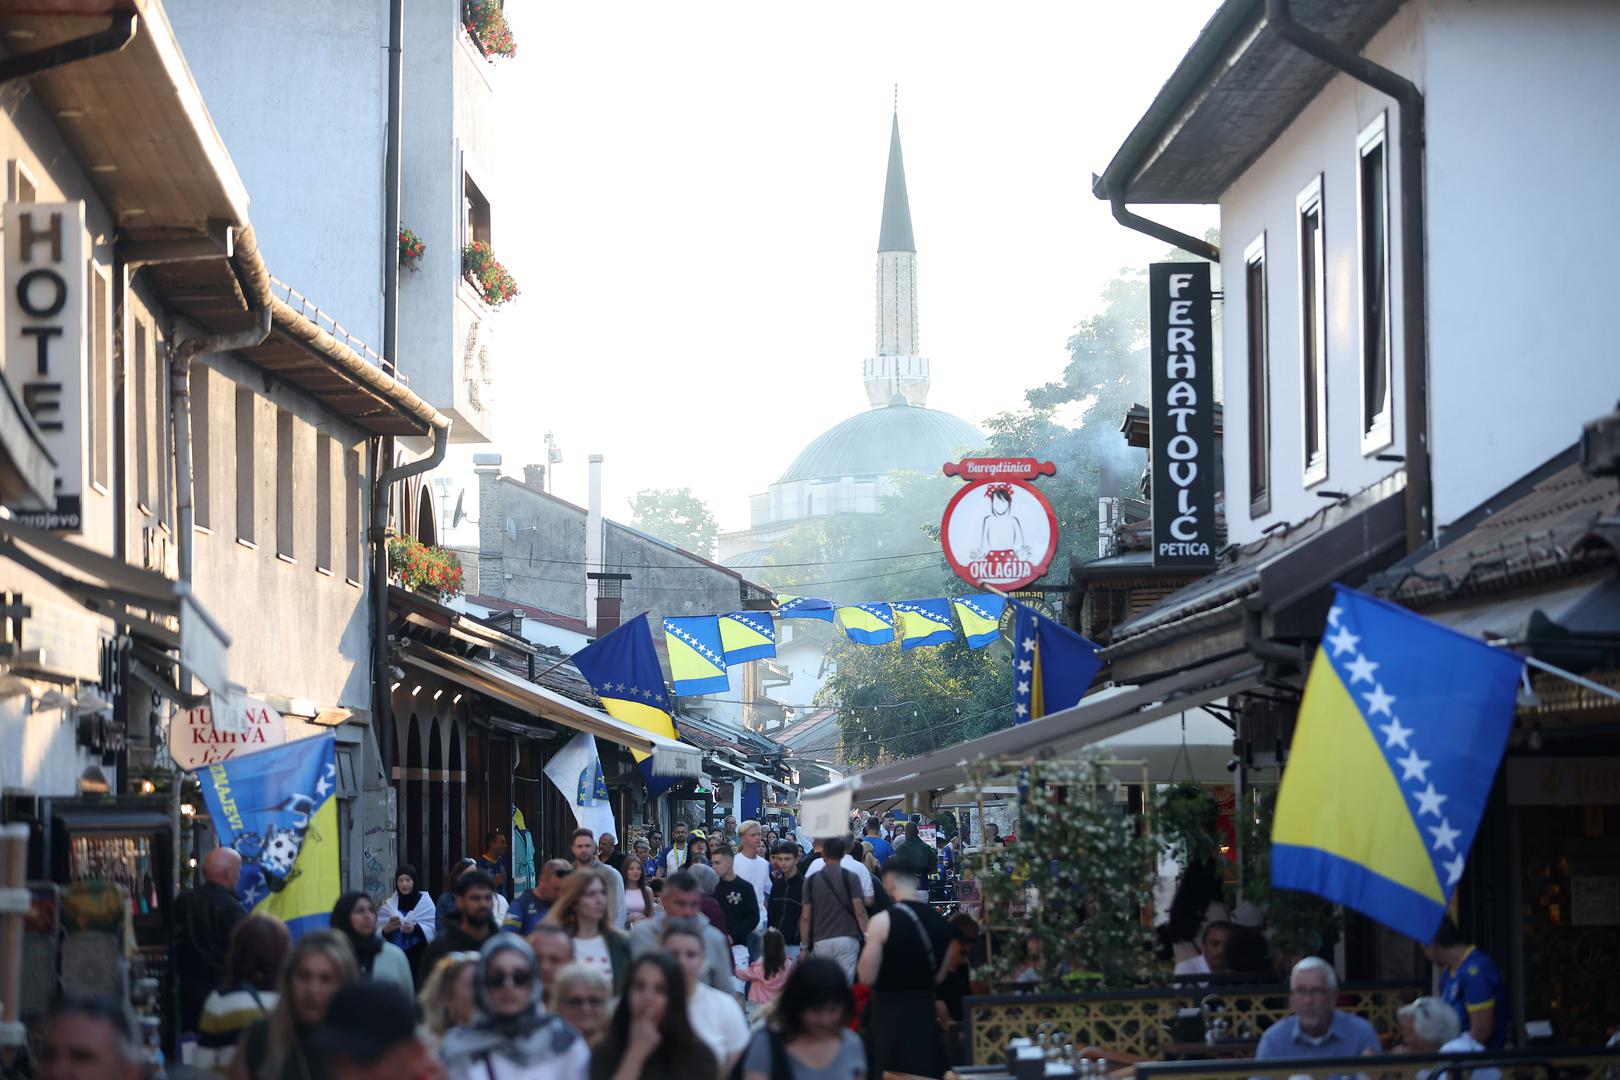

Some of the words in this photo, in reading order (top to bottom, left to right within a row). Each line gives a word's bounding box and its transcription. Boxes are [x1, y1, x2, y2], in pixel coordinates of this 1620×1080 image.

[17, 213, 67, 488] HOTE
[1166, 274, 1199, 541] FERHATOVIĆ
[967, 462, 1032, 476] Buregdžinica
[970, 561, 1031, 578] OKLAGIJA
[1159, 543, 1210, 556] PETICA
[208, 764, 245, 831] ZMAJEVI
